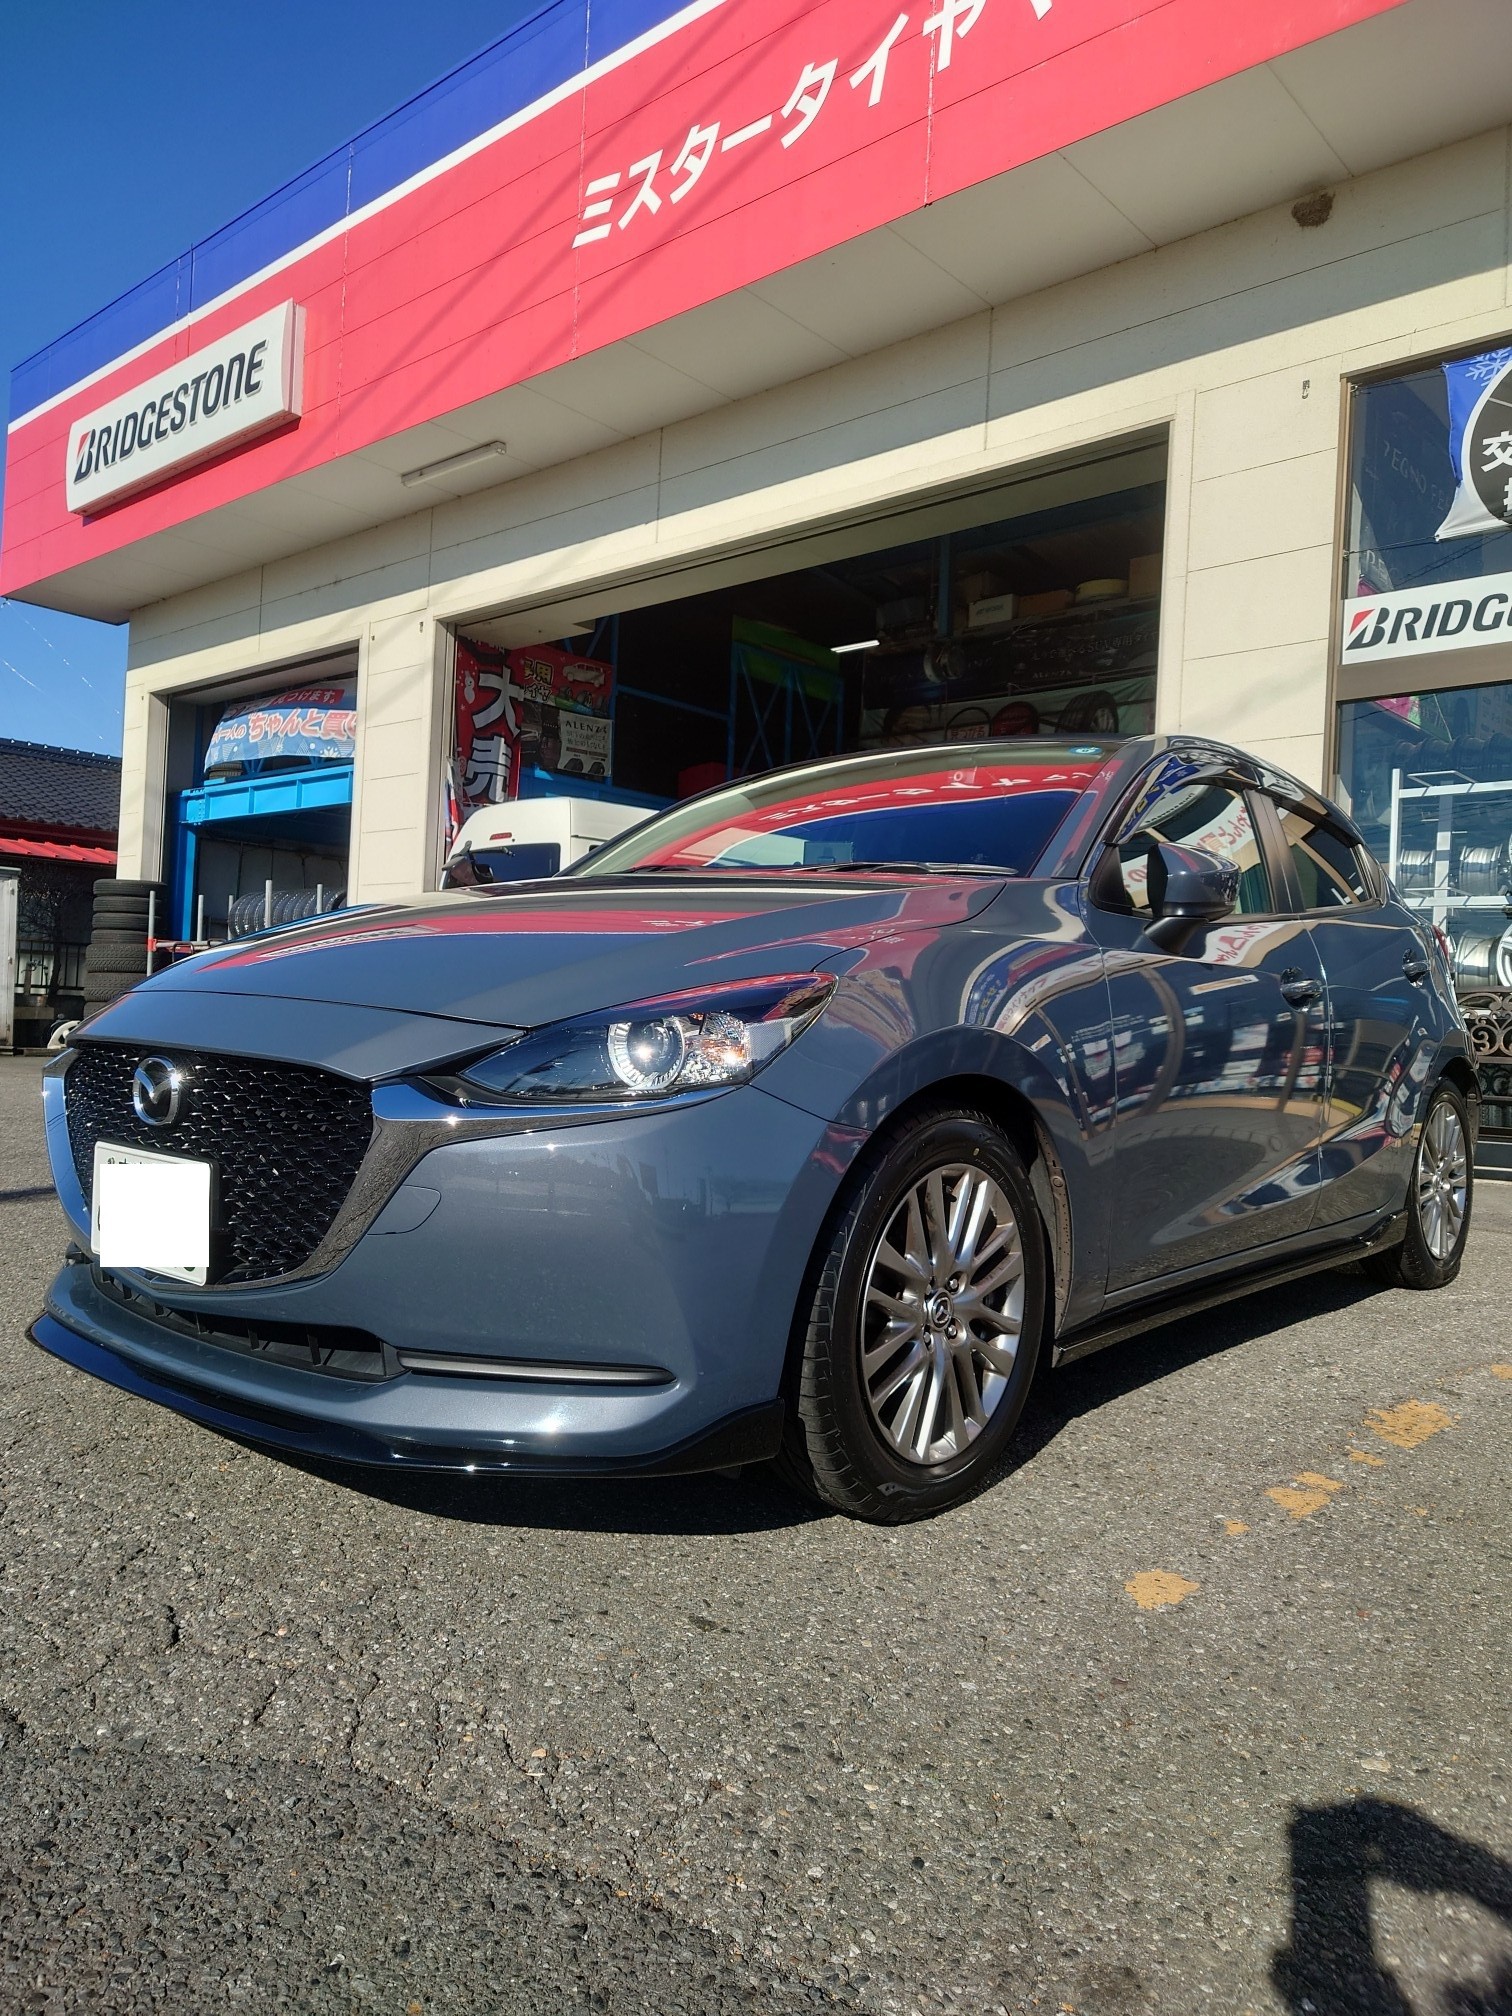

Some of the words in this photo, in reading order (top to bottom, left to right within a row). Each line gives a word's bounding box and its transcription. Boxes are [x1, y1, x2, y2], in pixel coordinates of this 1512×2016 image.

[572, 0, 1054, 249] ミスタータイヤ
[73, 338, 268, 484] BRIDGESTONE
[565, 720, 608, 734] ALENZA
